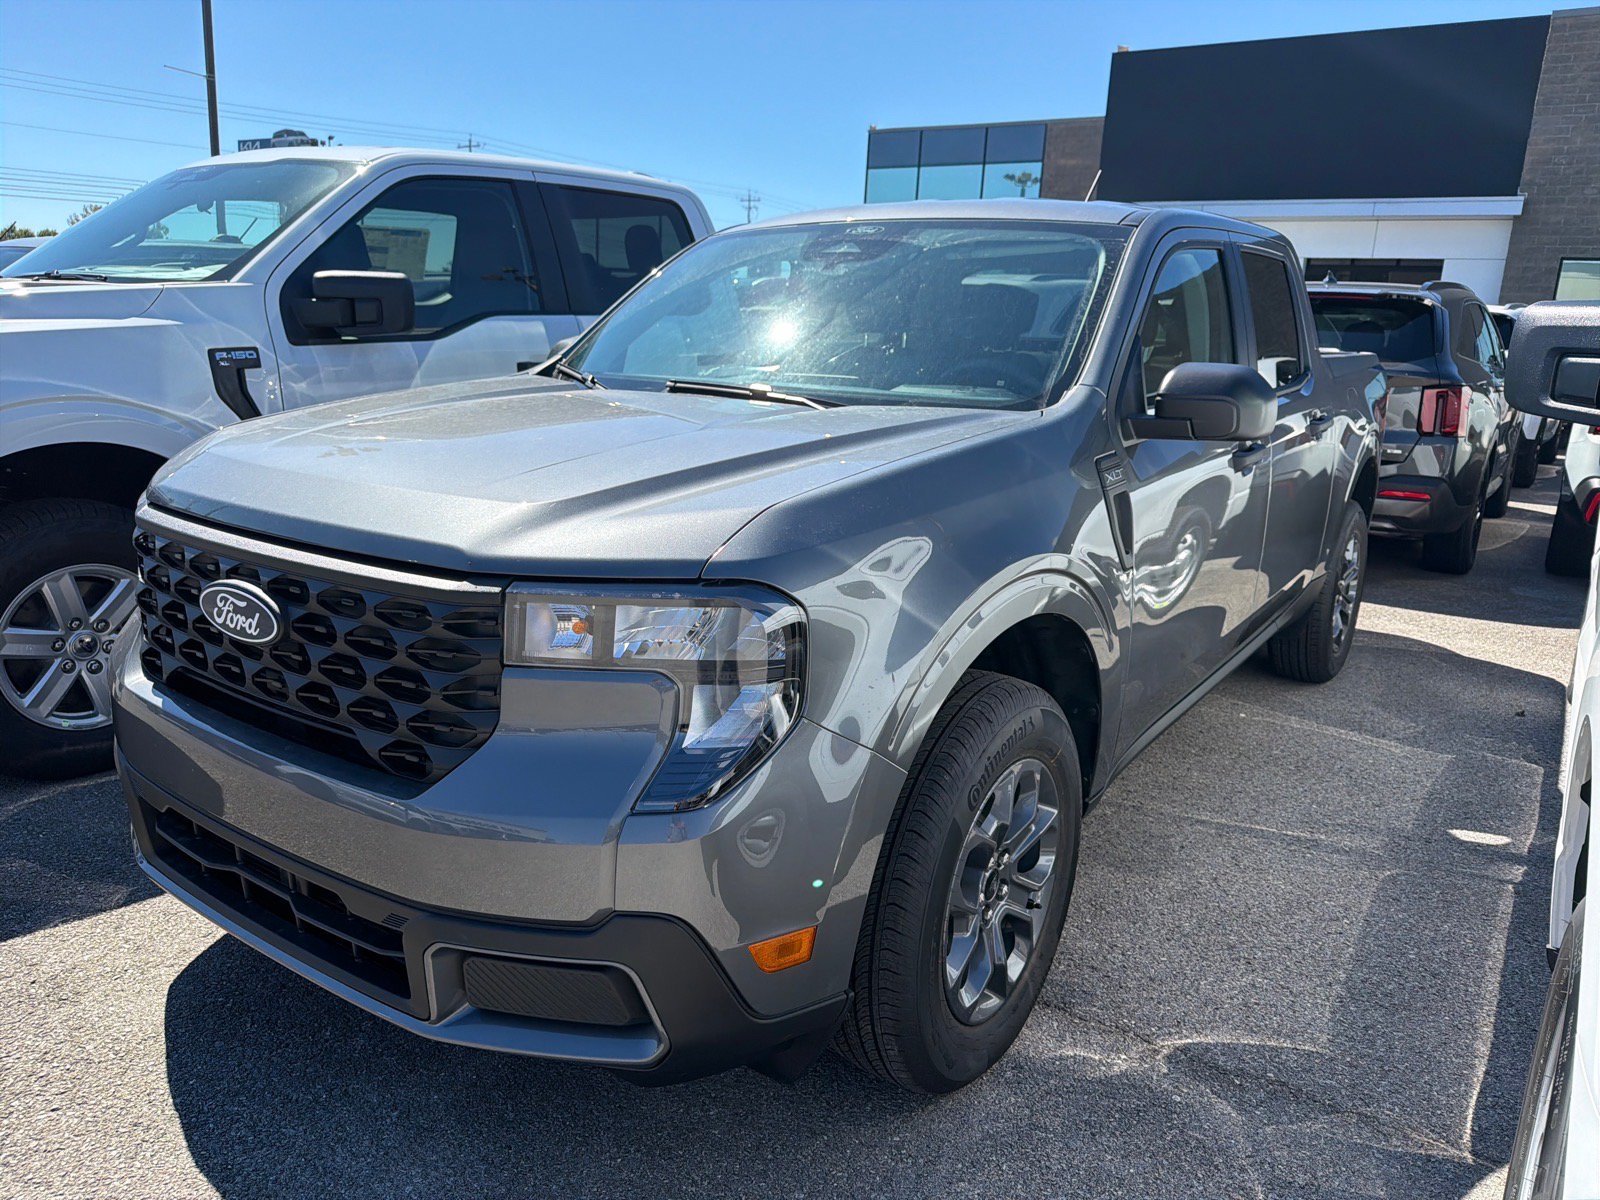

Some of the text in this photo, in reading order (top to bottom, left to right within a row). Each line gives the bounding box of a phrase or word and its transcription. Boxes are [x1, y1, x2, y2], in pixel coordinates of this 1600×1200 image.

[215, 350, 257, 360] F-150
[1104, 468, 1124, 484] XLT
[213, 593, 260, 636] Ford
[967, 719, 1028, 812] Continental
